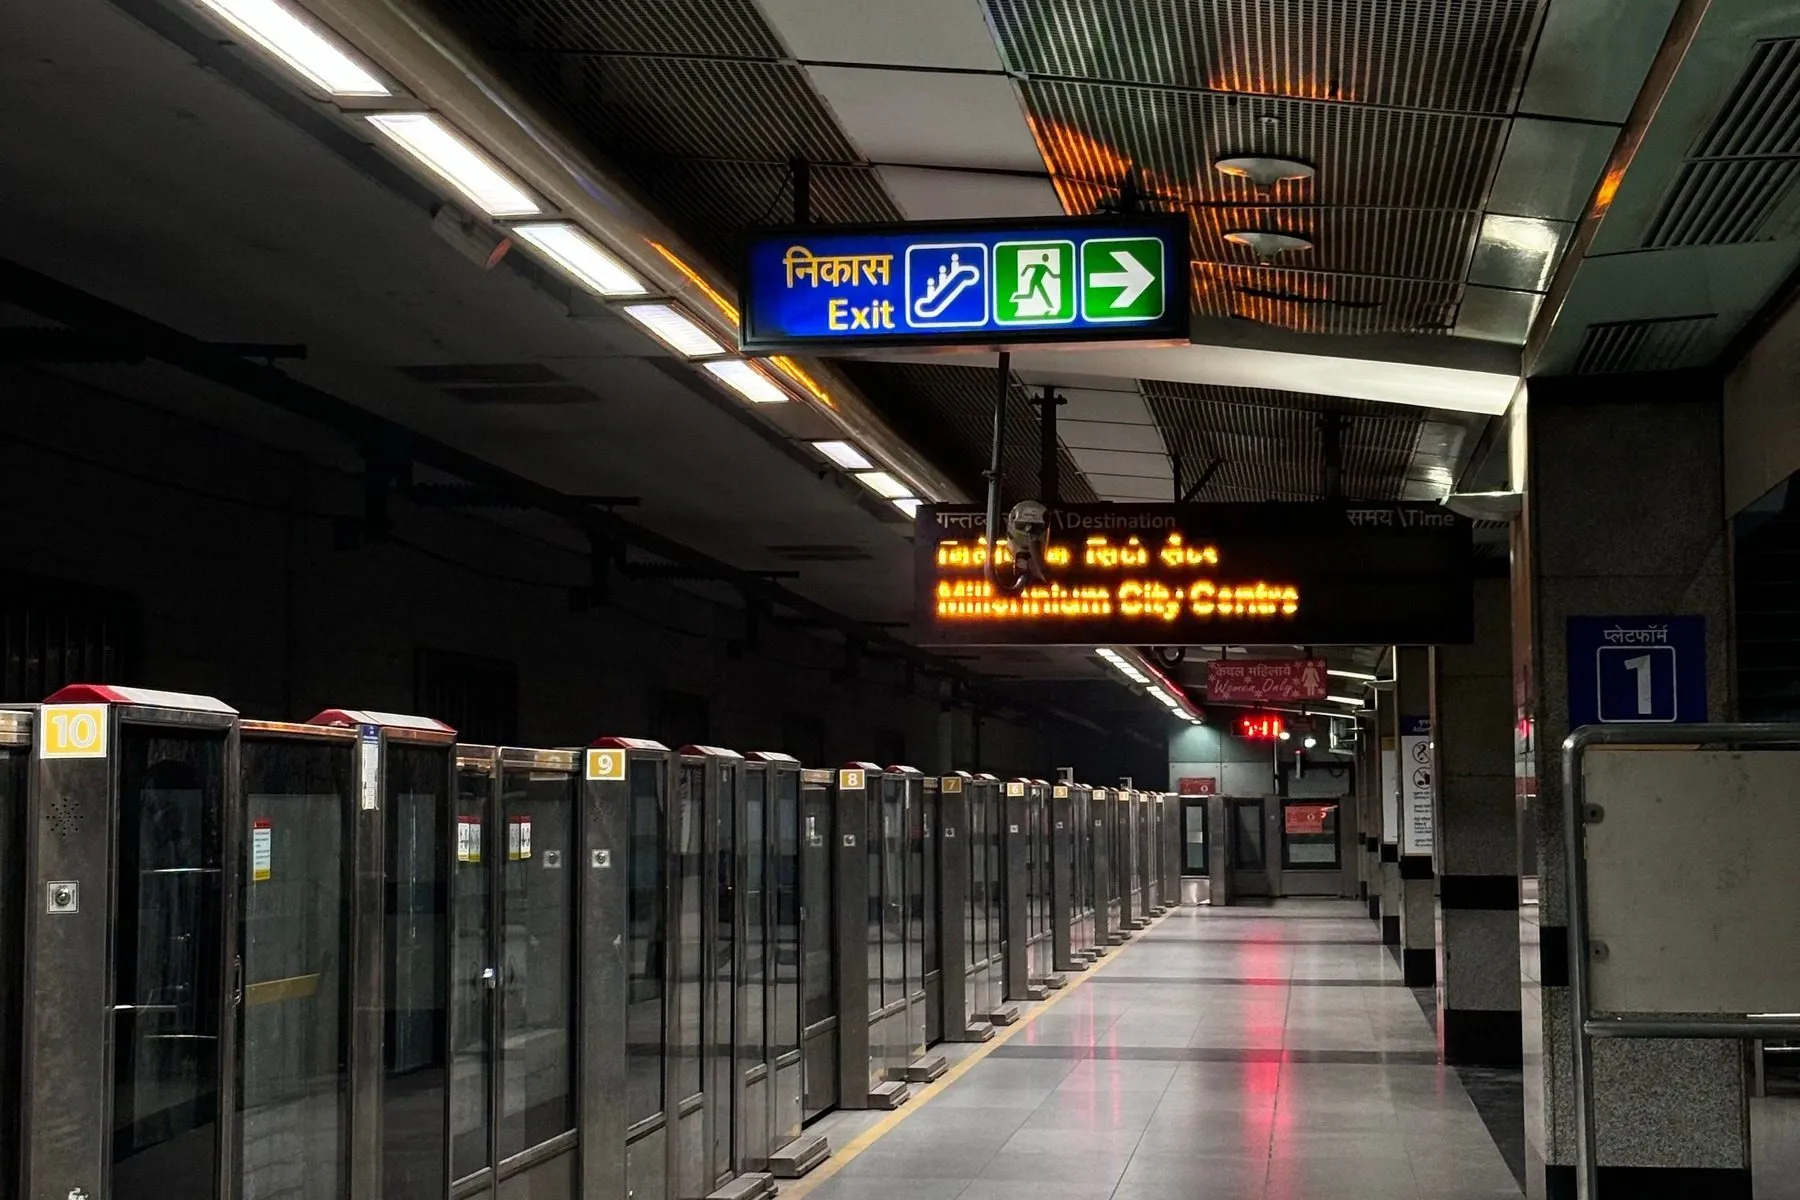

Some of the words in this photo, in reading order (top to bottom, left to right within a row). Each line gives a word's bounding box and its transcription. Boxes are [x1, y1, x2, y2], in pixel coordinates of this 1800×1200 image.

[783, 245, 894, 288] निकास
[828, 298, 895, 330] Exit
[1346, 508, 1394, 527] समय
[1118, 580, 1184, 621] City
[1603, 624, 1668, 643] प्लेटफॉर्म
[1215, 664, 1245, 677] केवल
[1214, 680, 1256, 694] Women
[1262, 678, 1293, 697] Only
[1624, 654, 1652, 714] 1
[52, 714, 97, 748] 10
[598, 754, 613, 775] 9
[848, 773, 857, 786] 8
[949, 780, 957, 790] 7
[1058, 787, 1064, 796] 5
